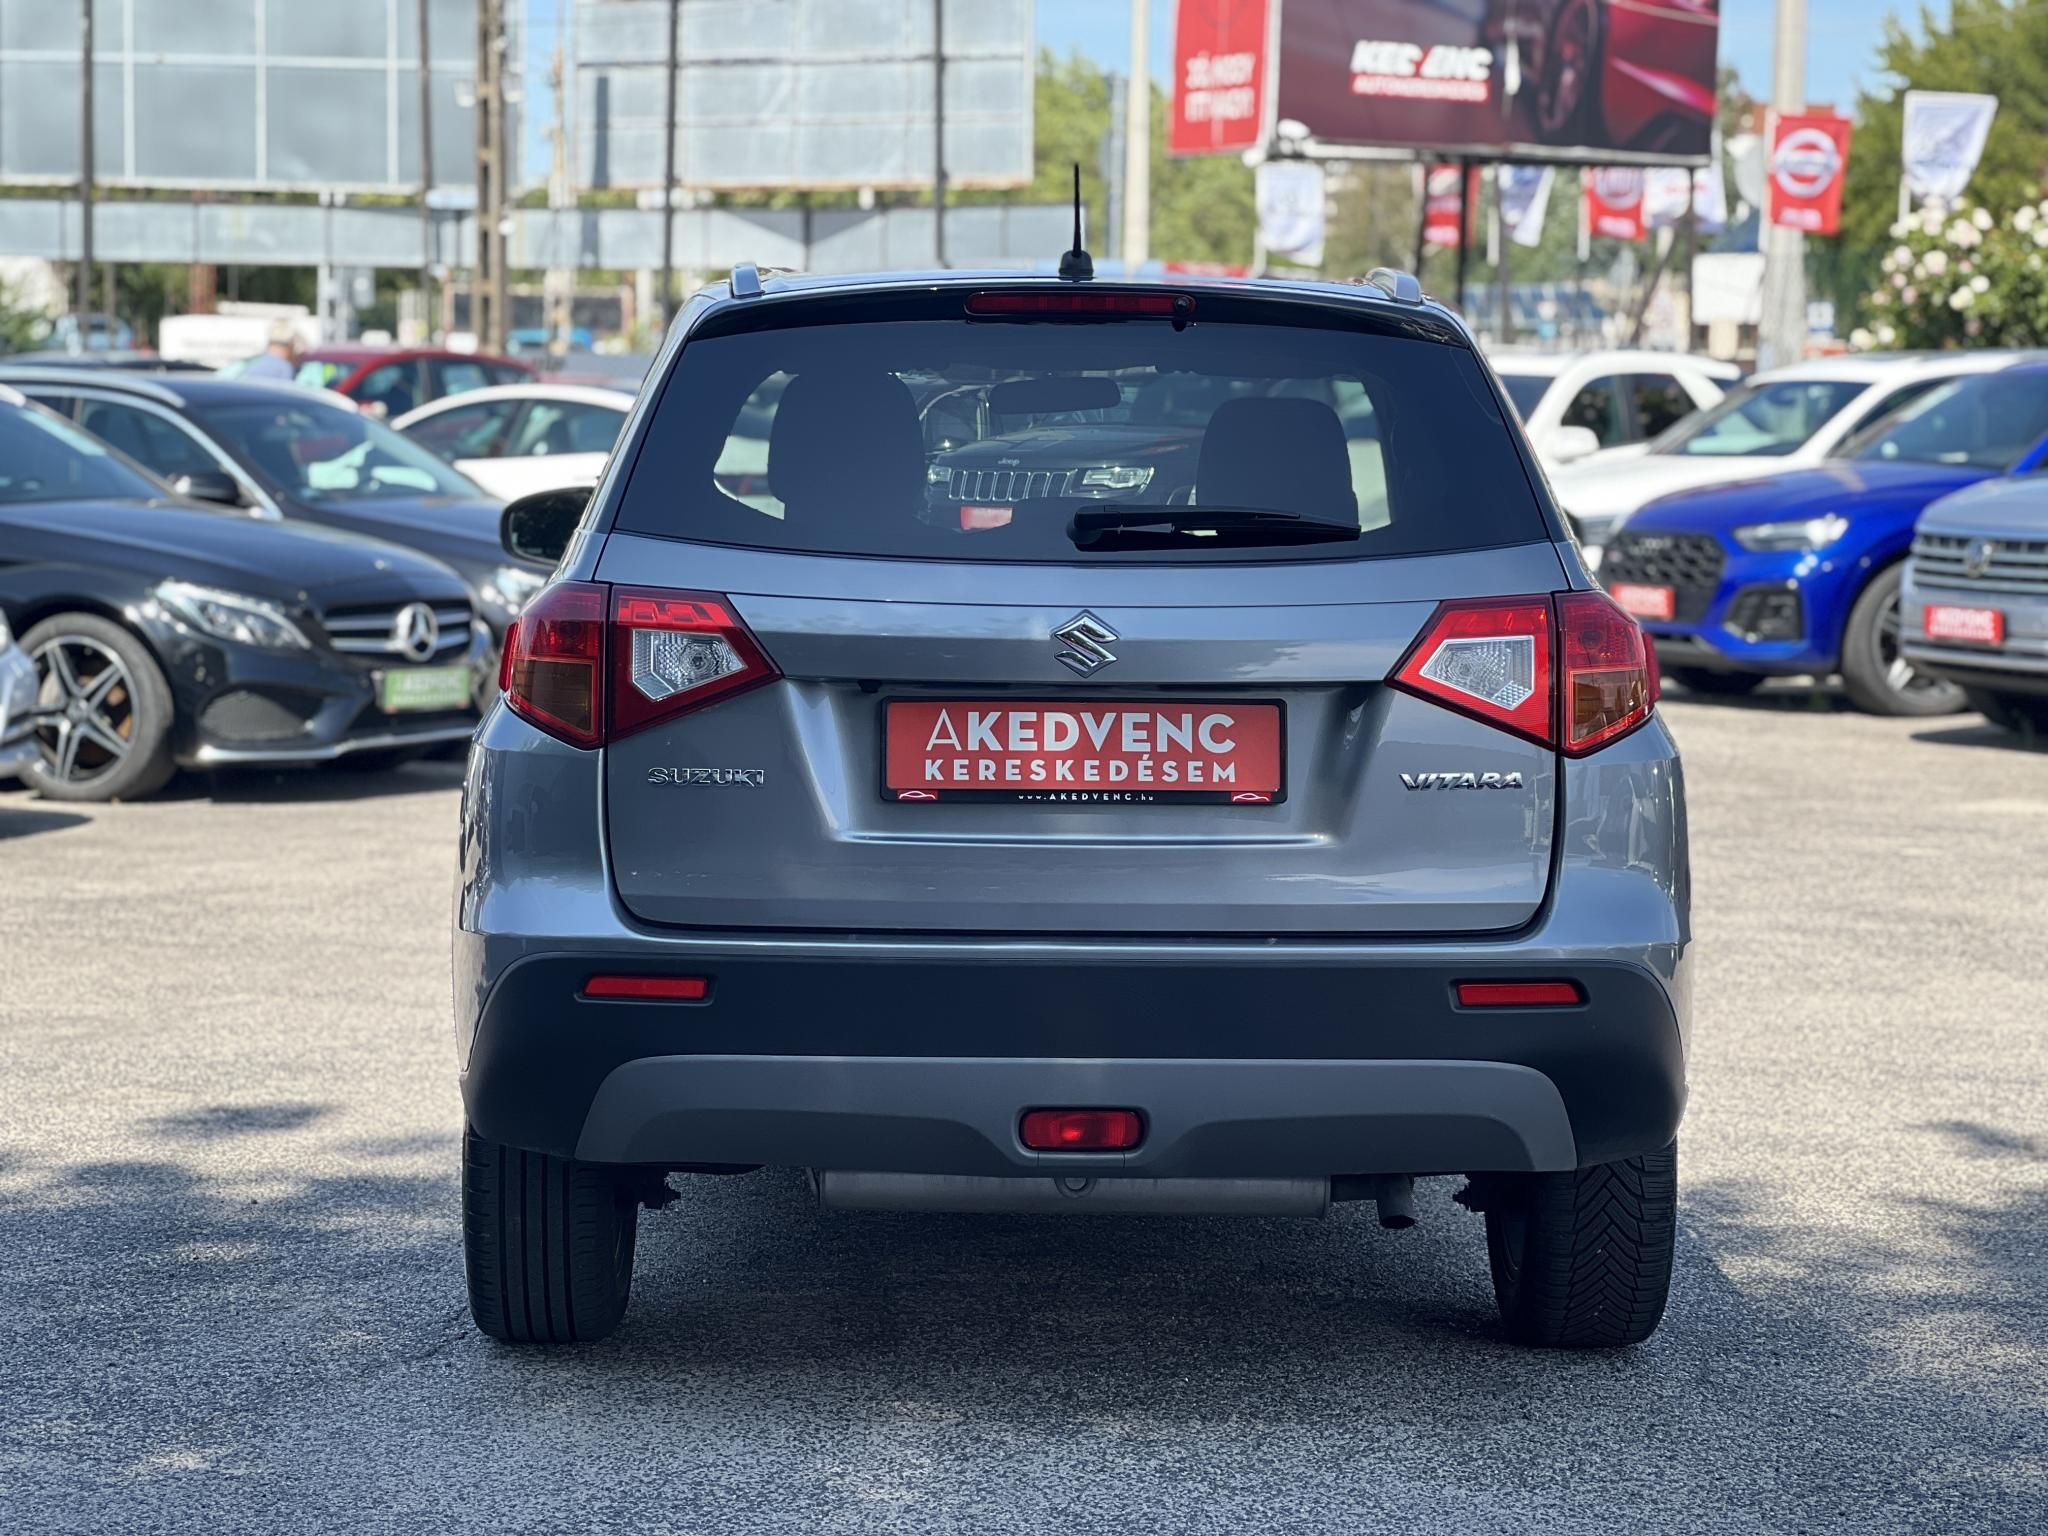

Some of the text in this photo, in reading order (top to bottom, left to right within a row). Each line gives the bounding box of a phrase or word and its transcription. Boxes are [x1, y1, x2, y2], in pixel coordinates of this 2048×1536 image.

[998, 457, 1020, 467] Jeep
[648, 767, 764, 787] SUZUKI
[925, 753, 1236, 783] KERESKEDÉSEM
[1399, 772, 1523, 791] VITARA
